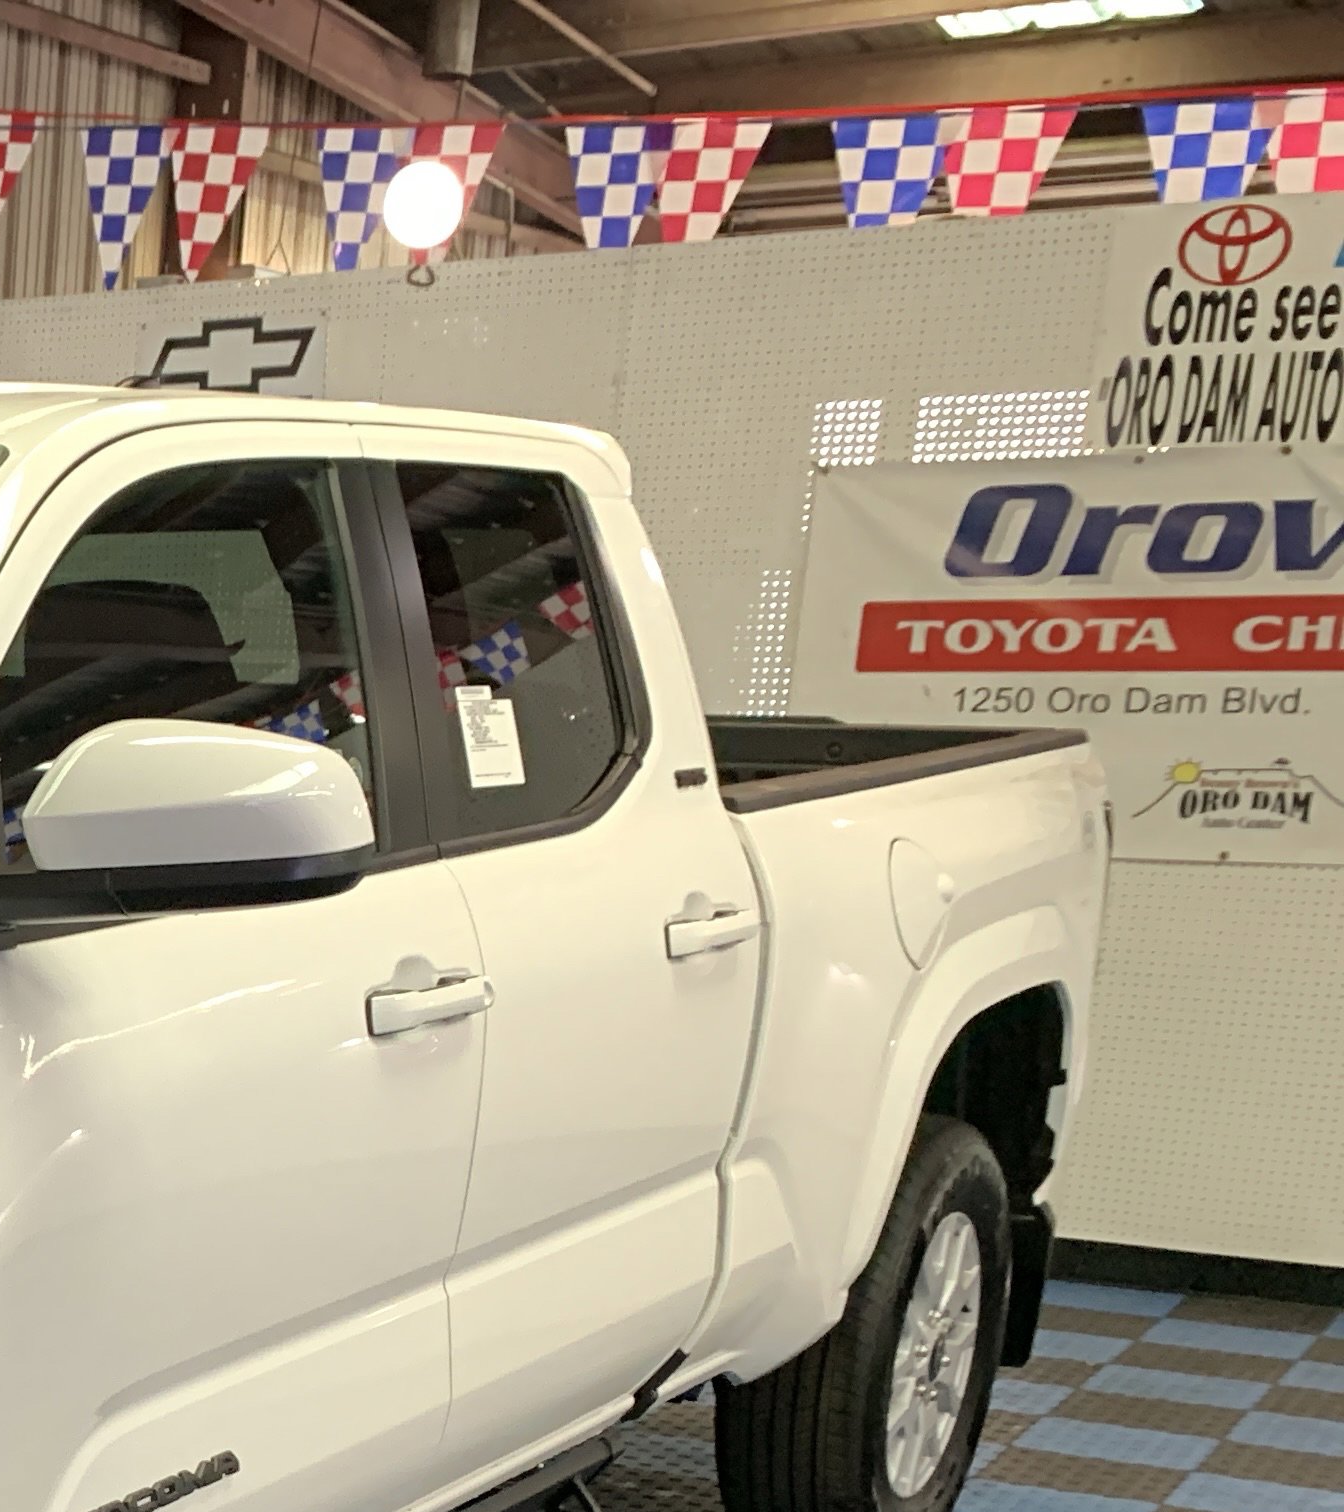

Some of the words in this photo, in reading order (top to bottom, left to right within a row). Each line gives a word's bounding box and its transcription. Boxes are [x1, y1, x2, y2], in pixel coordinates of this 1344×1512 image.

[1144, 266, 1258, 346] Come
[1269, 282, 1342, 342] see
[1177, 353, 1255, 444] DAM
[1253, 347, 1344, 443] AUTO
[896, 616, 1178, 655] TOYOTA
[1232, 614, 1344, 654] CH
[953, 686, 1036, 714] 1250
[1047, 686, 1111, 714] Oro
[1123, 686, 1208, 714] Dam
[1221, 687, 1311, 715] Blvd.
[1178, 789, 1240, 820] ORO
[1249, 790, 1314, 825] DAM
